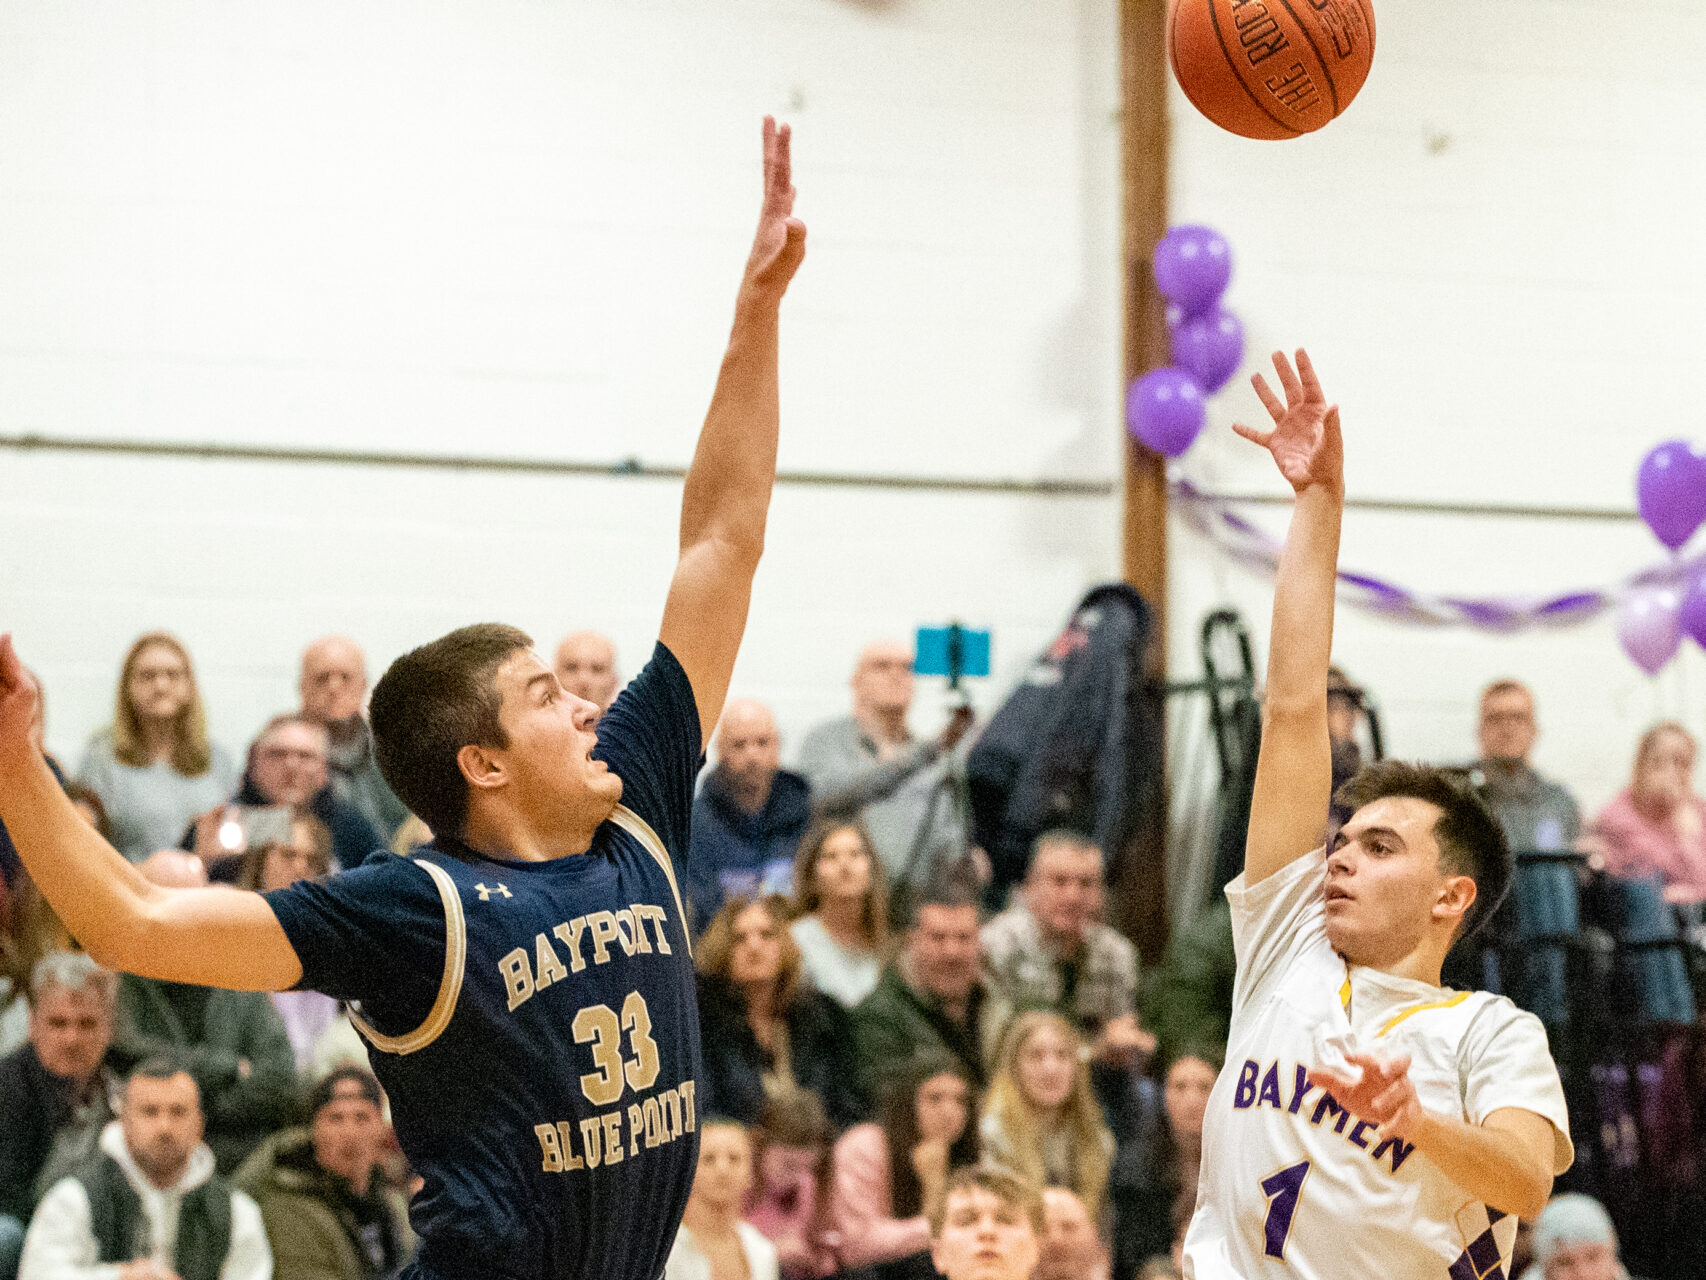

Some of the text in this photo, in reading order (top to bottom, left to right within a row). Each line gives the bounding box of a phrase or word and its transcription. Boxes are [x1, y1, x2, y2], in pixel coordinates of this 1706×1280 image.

[1264, 61, 1320, 114] THE
[572, 990, 660, 1106] 33
[534, 1112, 624, 1173] BLUE
[1233, 1058, 1417, 1175] BAYMEN
[1258, 1159, 1311, 1262] 1
